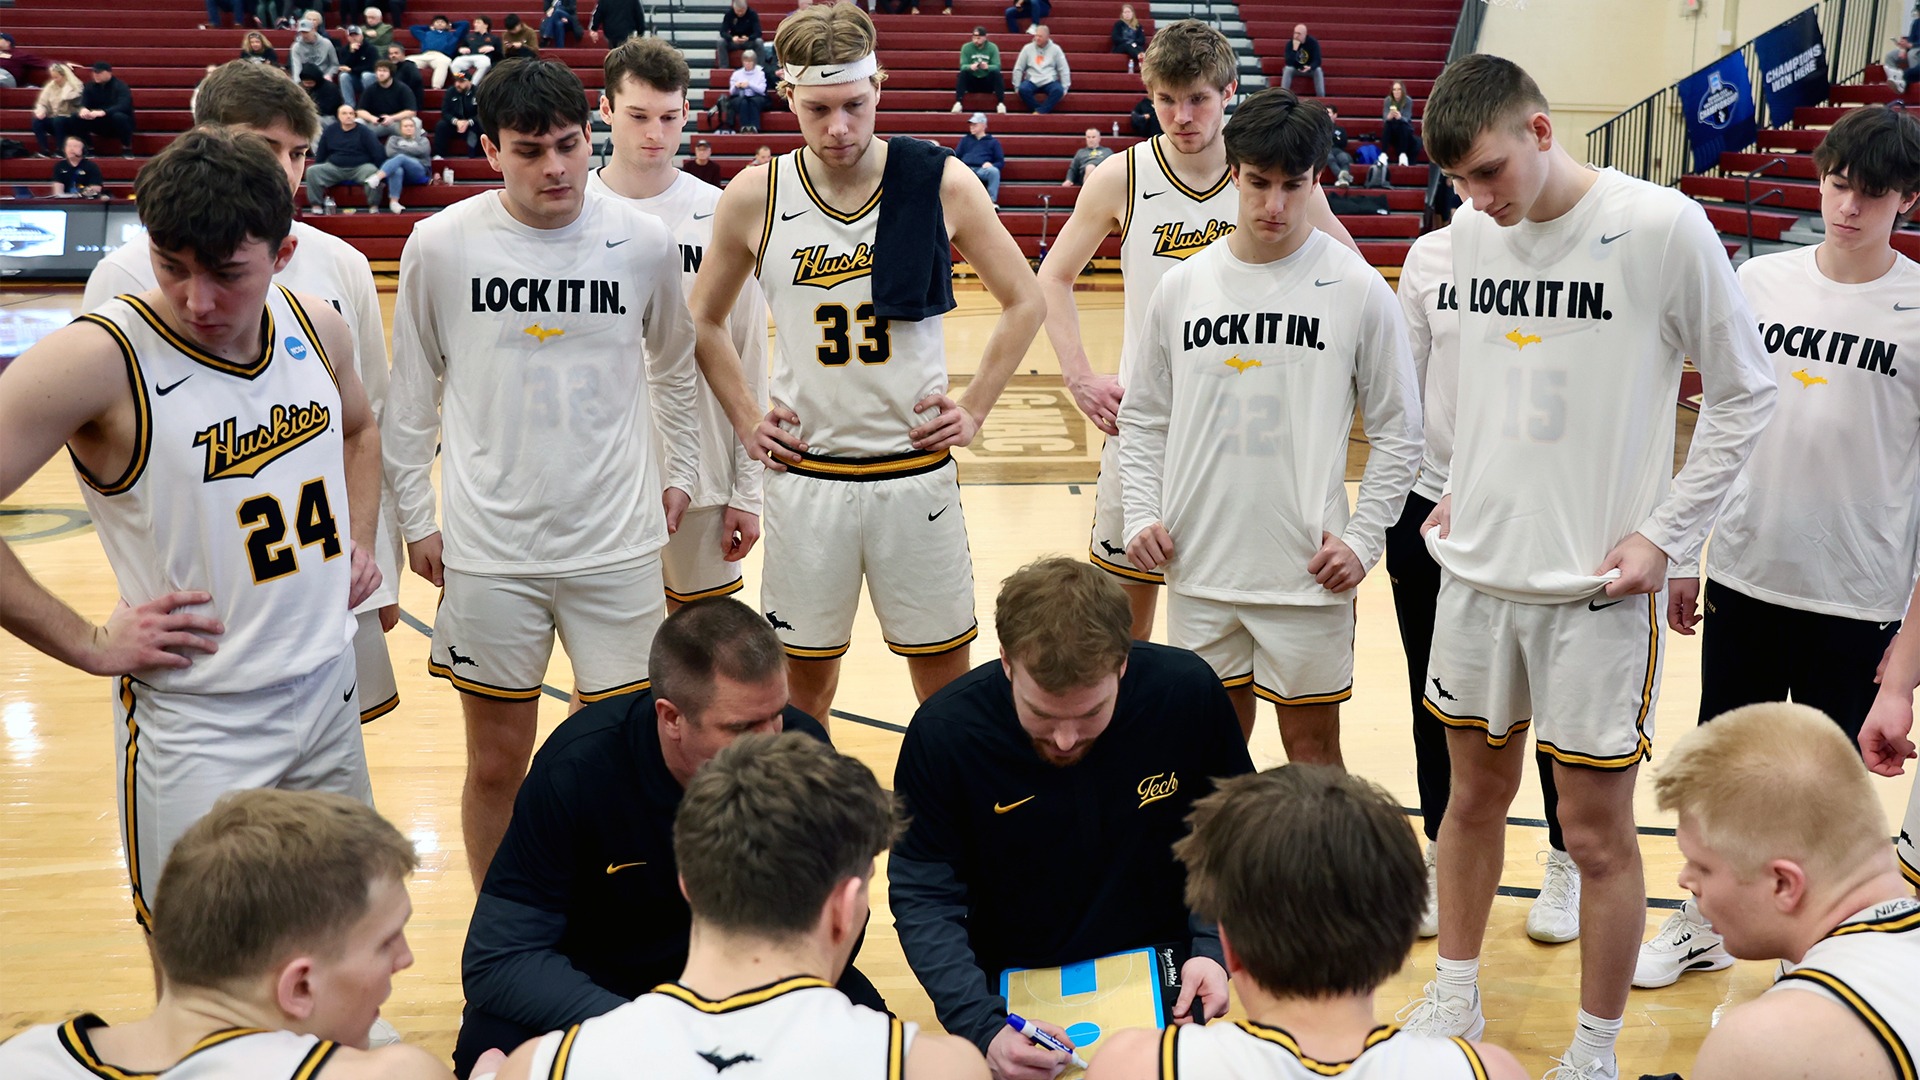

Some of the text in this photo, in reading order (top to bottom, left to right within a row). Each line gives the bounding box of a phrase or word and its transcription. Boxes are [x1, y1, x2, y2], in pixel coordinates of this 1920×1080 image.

[1766, 43, 1821, 83] CHAMPIONS
[1771, 59, 1817, 92] WIN HERE
[792, 243, 875, 288] Huski
[472, 277, 626, 314] LOCK IT IN.
[1470, 278, 1612, 320] LOCK IT IN.
[814, 302, 892, 367] 33
[1184, 313, 1325, 351] LOCK IT IN.
[1758, 323, 1897, 377] OCK IT IN.
[193, 401, 330, 482] Huskies
[236, 476, 343, 586] 24
[1137, 771, 1178, 806] Tech
[1875, 900, 1910, 919] NIKE
